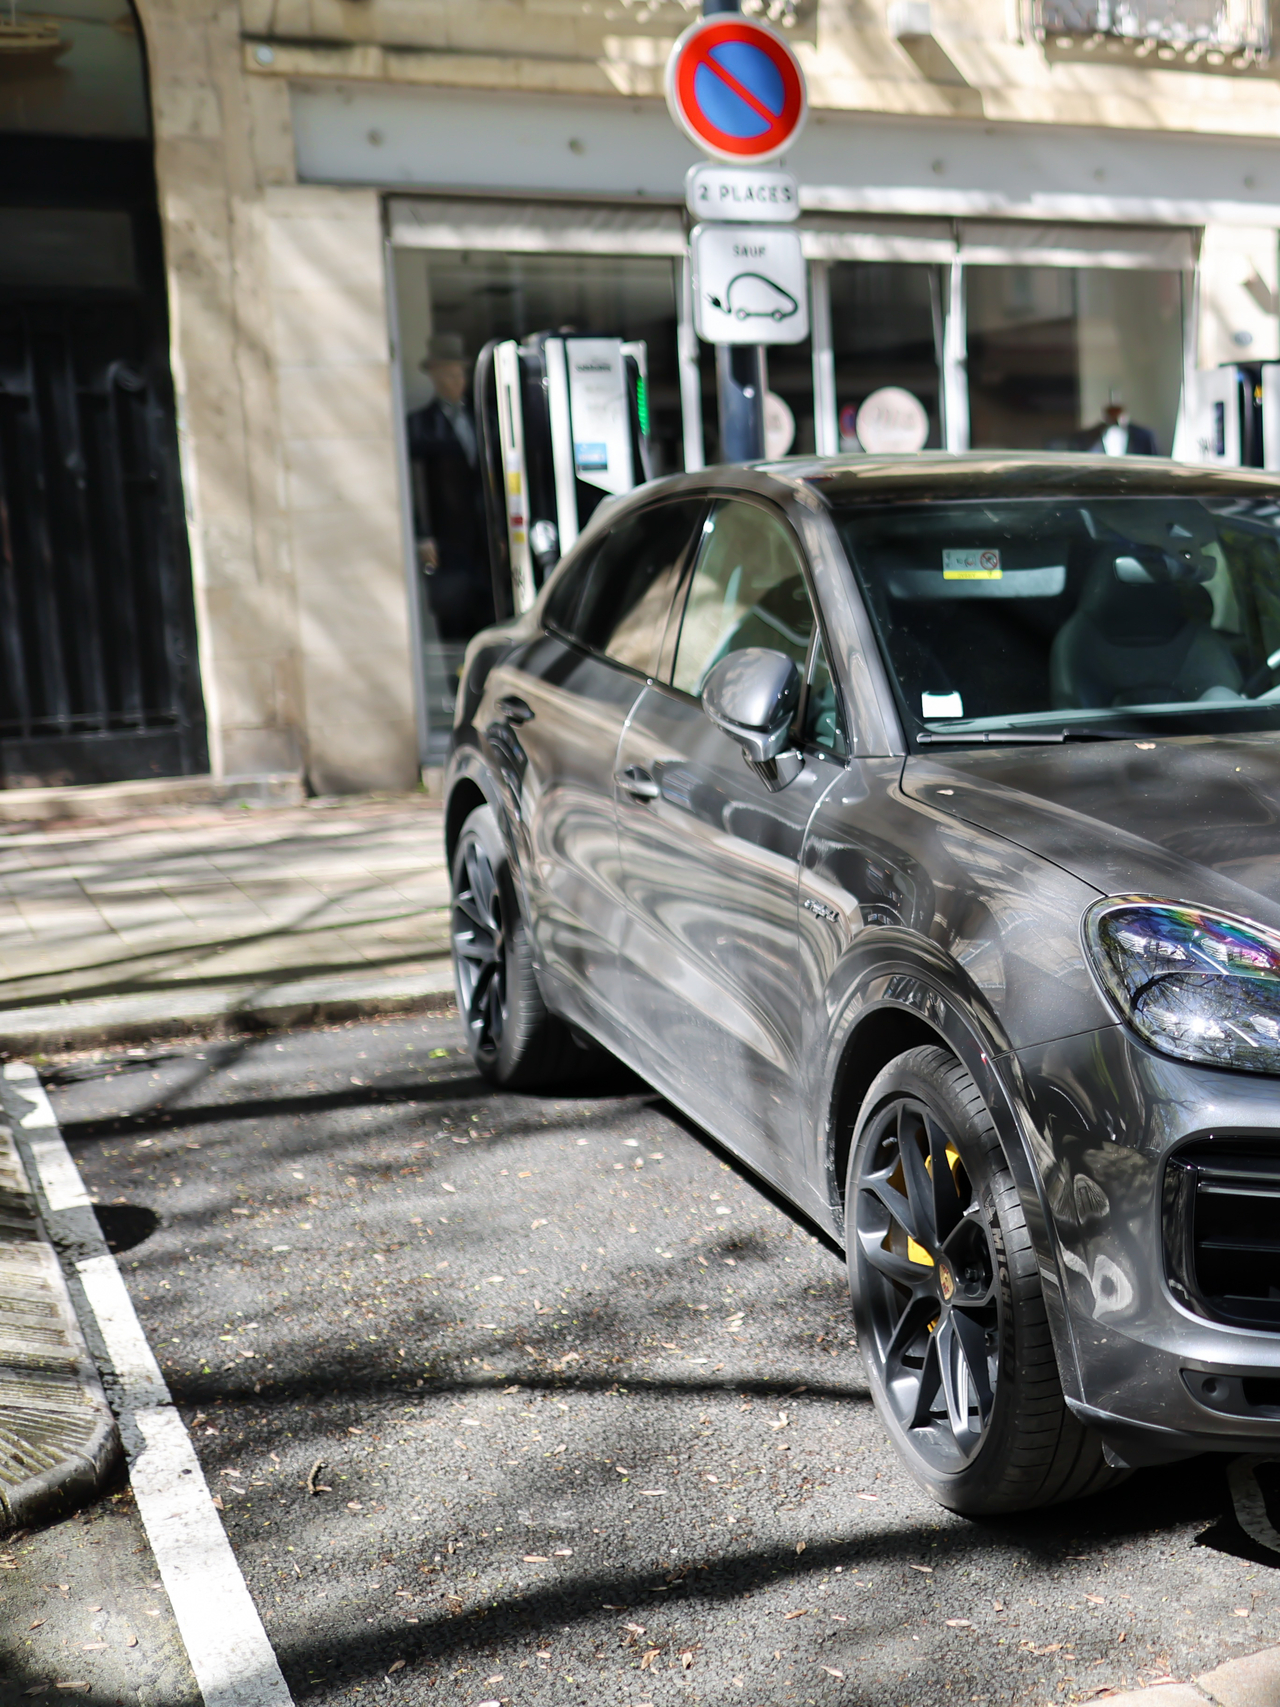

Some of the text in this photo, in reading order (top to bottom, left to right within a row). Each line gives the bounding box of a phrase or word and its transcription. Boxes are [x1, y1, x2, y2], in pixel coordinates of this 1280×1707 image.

[698, 184, 793, 203] 2 PLACES
[732, 244, 766, 258] SAUF
[990, 1226, 1016, 1383] MICHELIN
